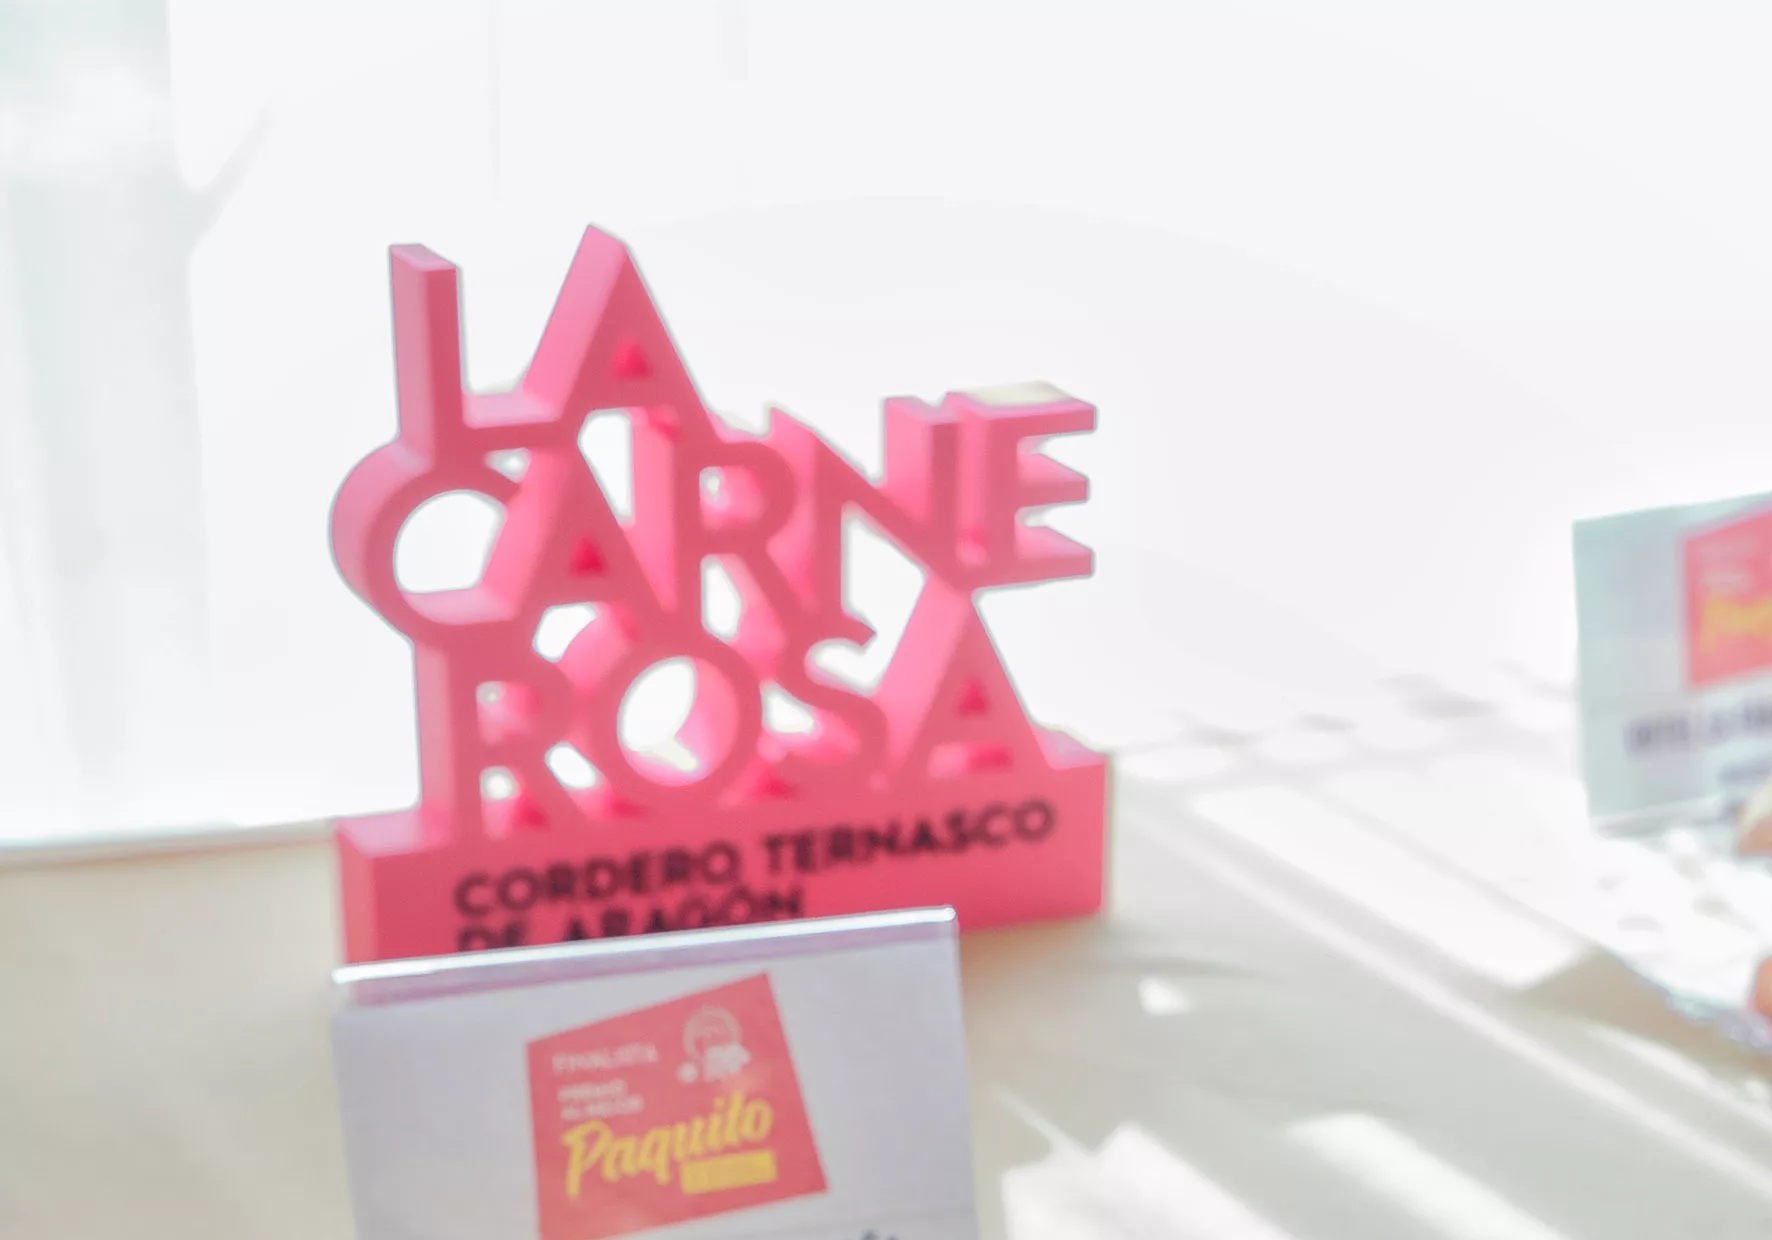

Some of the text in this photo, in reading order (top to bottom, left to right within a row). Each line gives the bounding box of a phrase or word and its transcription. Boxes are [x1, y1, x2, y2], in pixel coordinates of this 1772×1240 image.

[389, 224, 718, 466] LA
[328, 380, 1096, 626] CARNE
[412, 570, 1050, 838] ROSA
[455, 798, 1056, 918] CORDERO TERNASCO
[560, 1089, 774, 1200] Paquito
